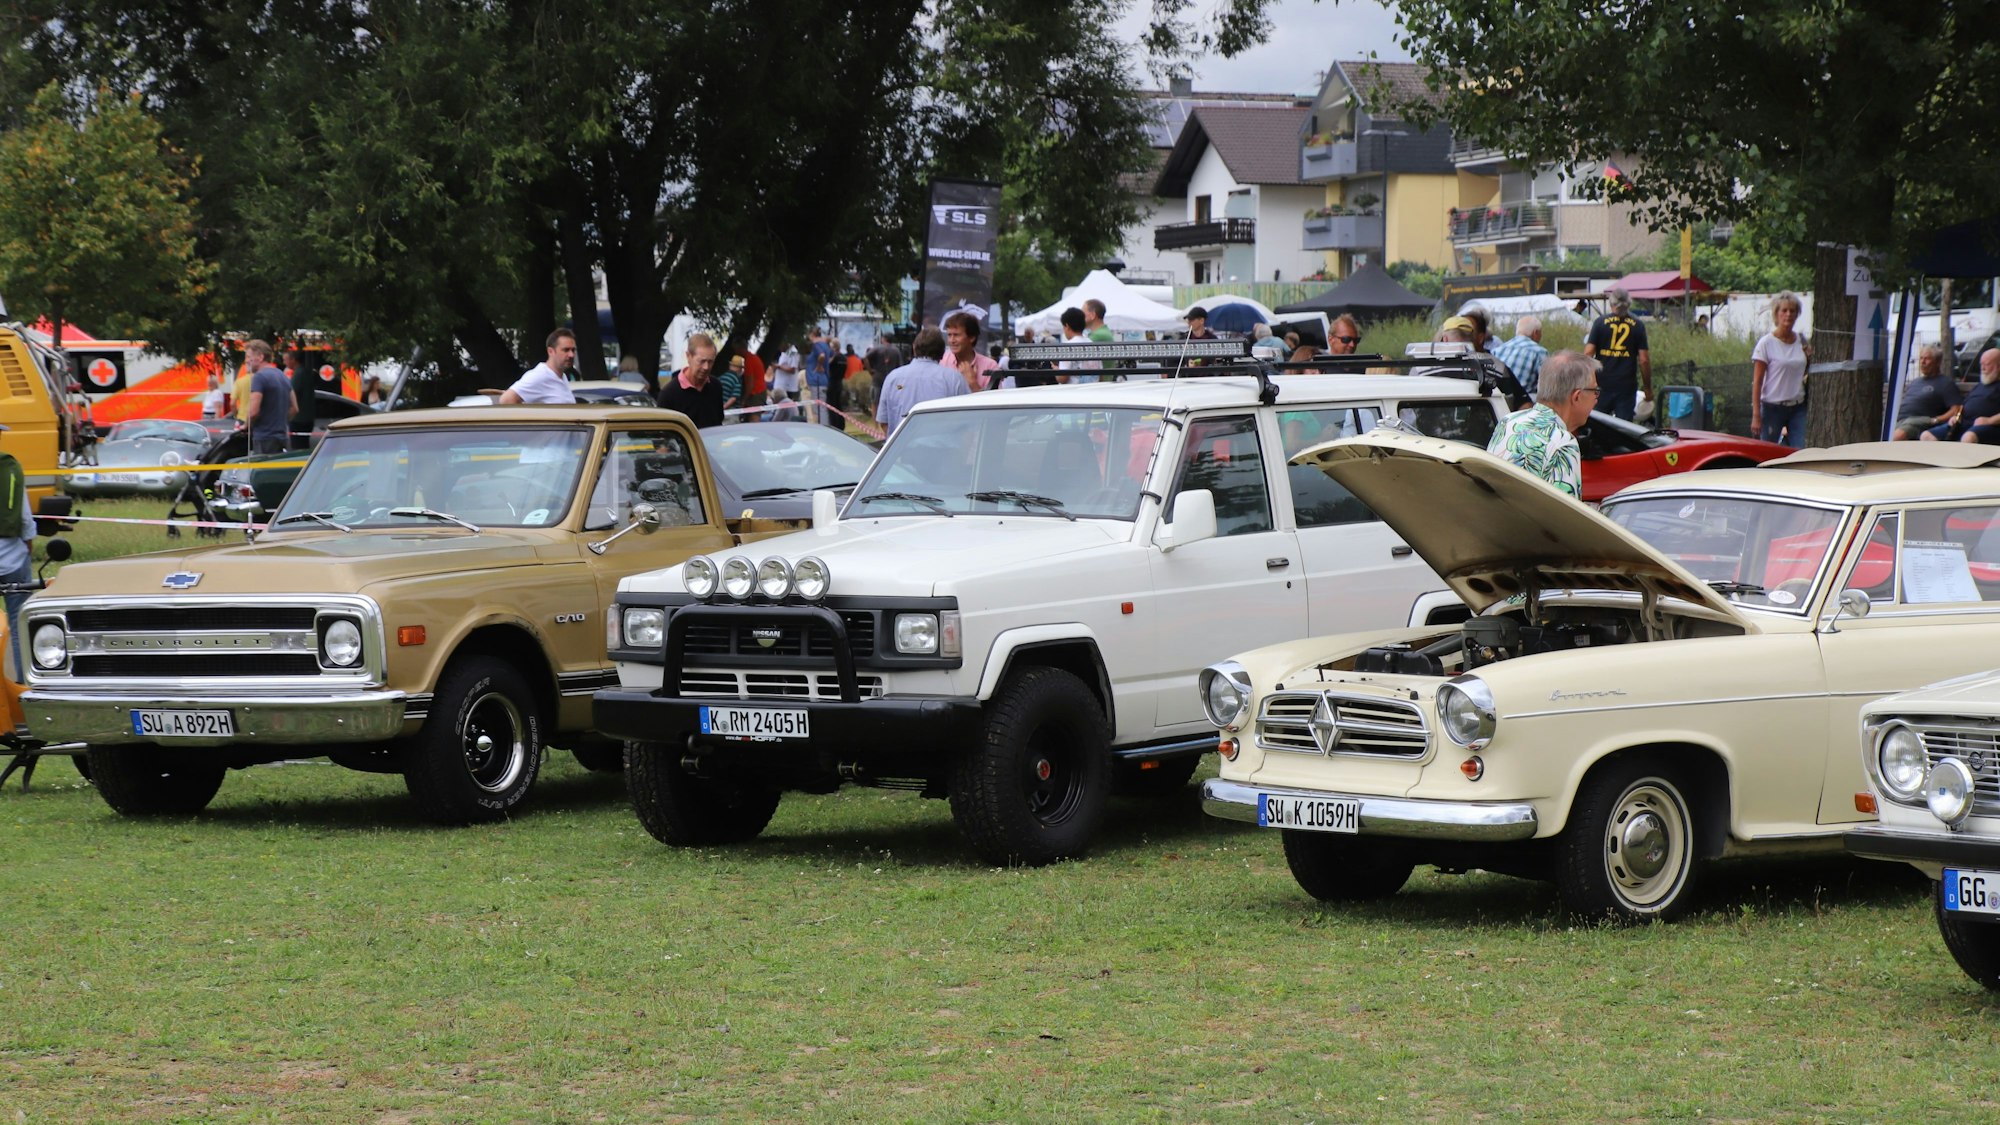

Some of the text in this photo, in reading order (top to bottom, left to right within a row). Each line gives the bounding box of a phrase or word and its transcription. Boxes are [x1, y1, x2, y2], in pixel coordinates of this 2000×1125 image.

[952, 211, 986, 225] SLS
[928, 248, 991, 262] WWW.SLS-CLUB.DE
[1610, 322, 1630, 350] 12
[555, 613, 586, 623] C/10
[110, 638, 262, 647] CHEVROLET
[752, 630, 781, 638] NISSAN
[455, 677, 491, 736] COOPER
[141, 713, 231, 734] SU A 892H
[710, 710, 720, 731] K
[730, 711, 750, 732] RM
[753, 712, 807, 734] 2405H
[507, 715, 539, 806] DISCOVERER
[1267, 798, 1284, 824] SU
[1294, 800, 1303, 825] K
[1307, 801, 1356, 829] 1059H
[1959, 876, 1986, 907] GG
